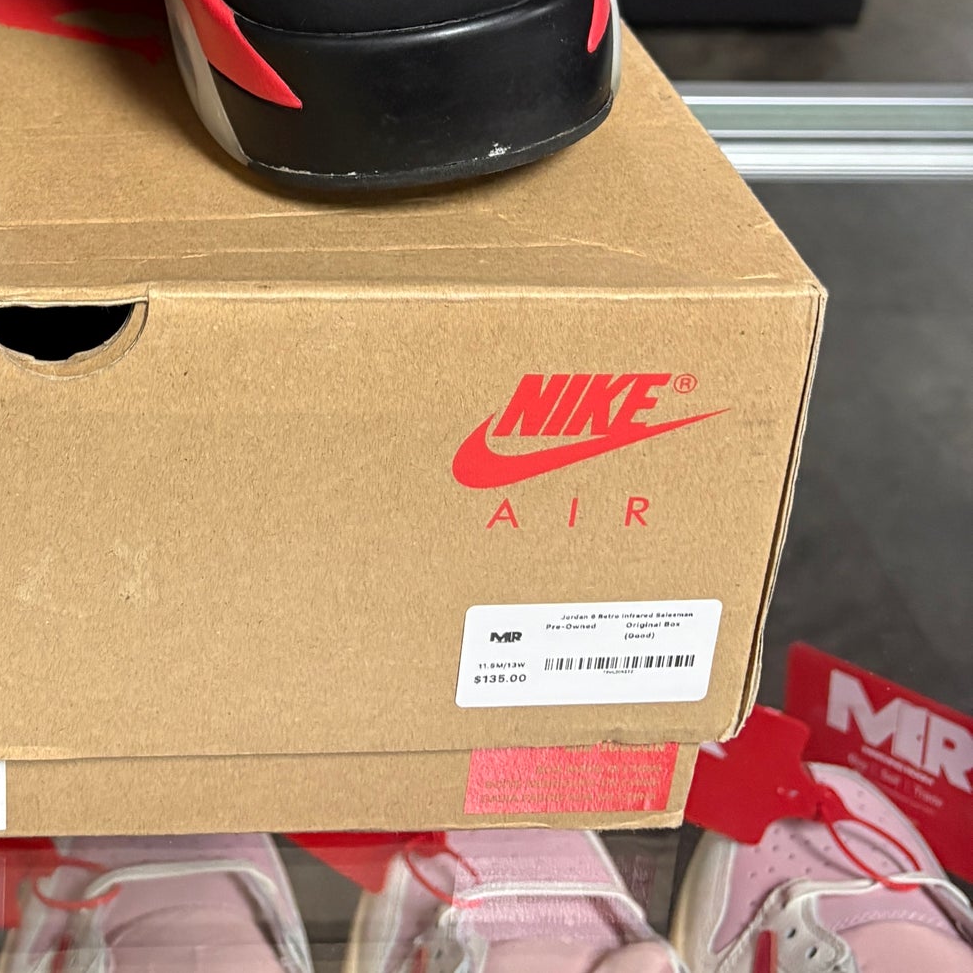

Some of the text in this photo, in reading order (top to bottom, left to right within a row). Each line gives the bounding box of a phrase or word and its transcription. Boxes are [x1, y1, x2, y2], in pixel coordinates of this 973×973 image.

[491, 373, 672, 436] NIKE
[486, 496, 649, 529] AIR
[626, 621, 661, 629] Original
[474, 674, 527, 684] $135.00
